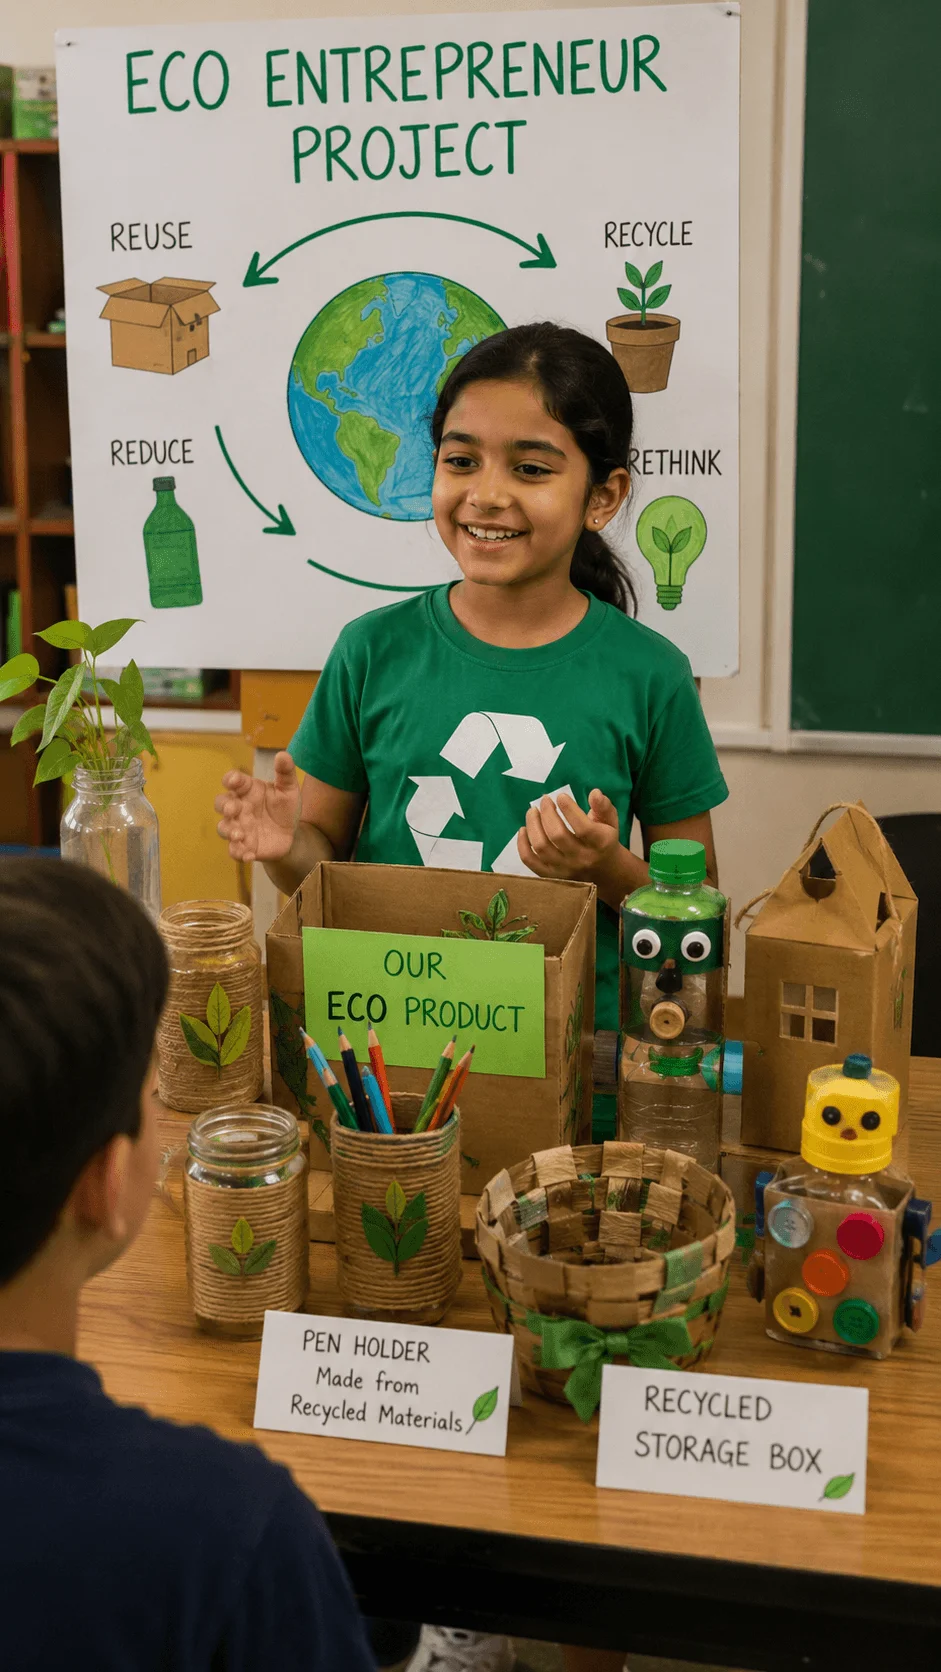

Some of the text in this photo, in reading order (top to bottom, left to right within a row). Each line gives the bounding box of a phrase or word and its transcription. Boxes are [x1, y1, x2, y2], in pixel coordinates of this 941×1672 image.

[125, 34, 668, 115] ECO ENTREPRENEUR
[292, 119, 528, 184] PROJECT
[110, 221, 193, 252] REUSE
[604, 220, 693, 249] RECYCLE
[110, 438, 195, 466] REDUCE
[629, 448, 722, 476] RETHINK
[383, 949, 447, 981] OUR
[327, 990, 526, 1033] ECO PRODUCT
[302, 1329, 431, 1364] PEN HOLDER
[315, 1366, 419, 1395] Made from
[290, 1393, 463, 1433] Recycled Materials
[644, 1384, 773, 1422] RECYCLED
[634, 1430, 822, 1474] STORAGE BOX
